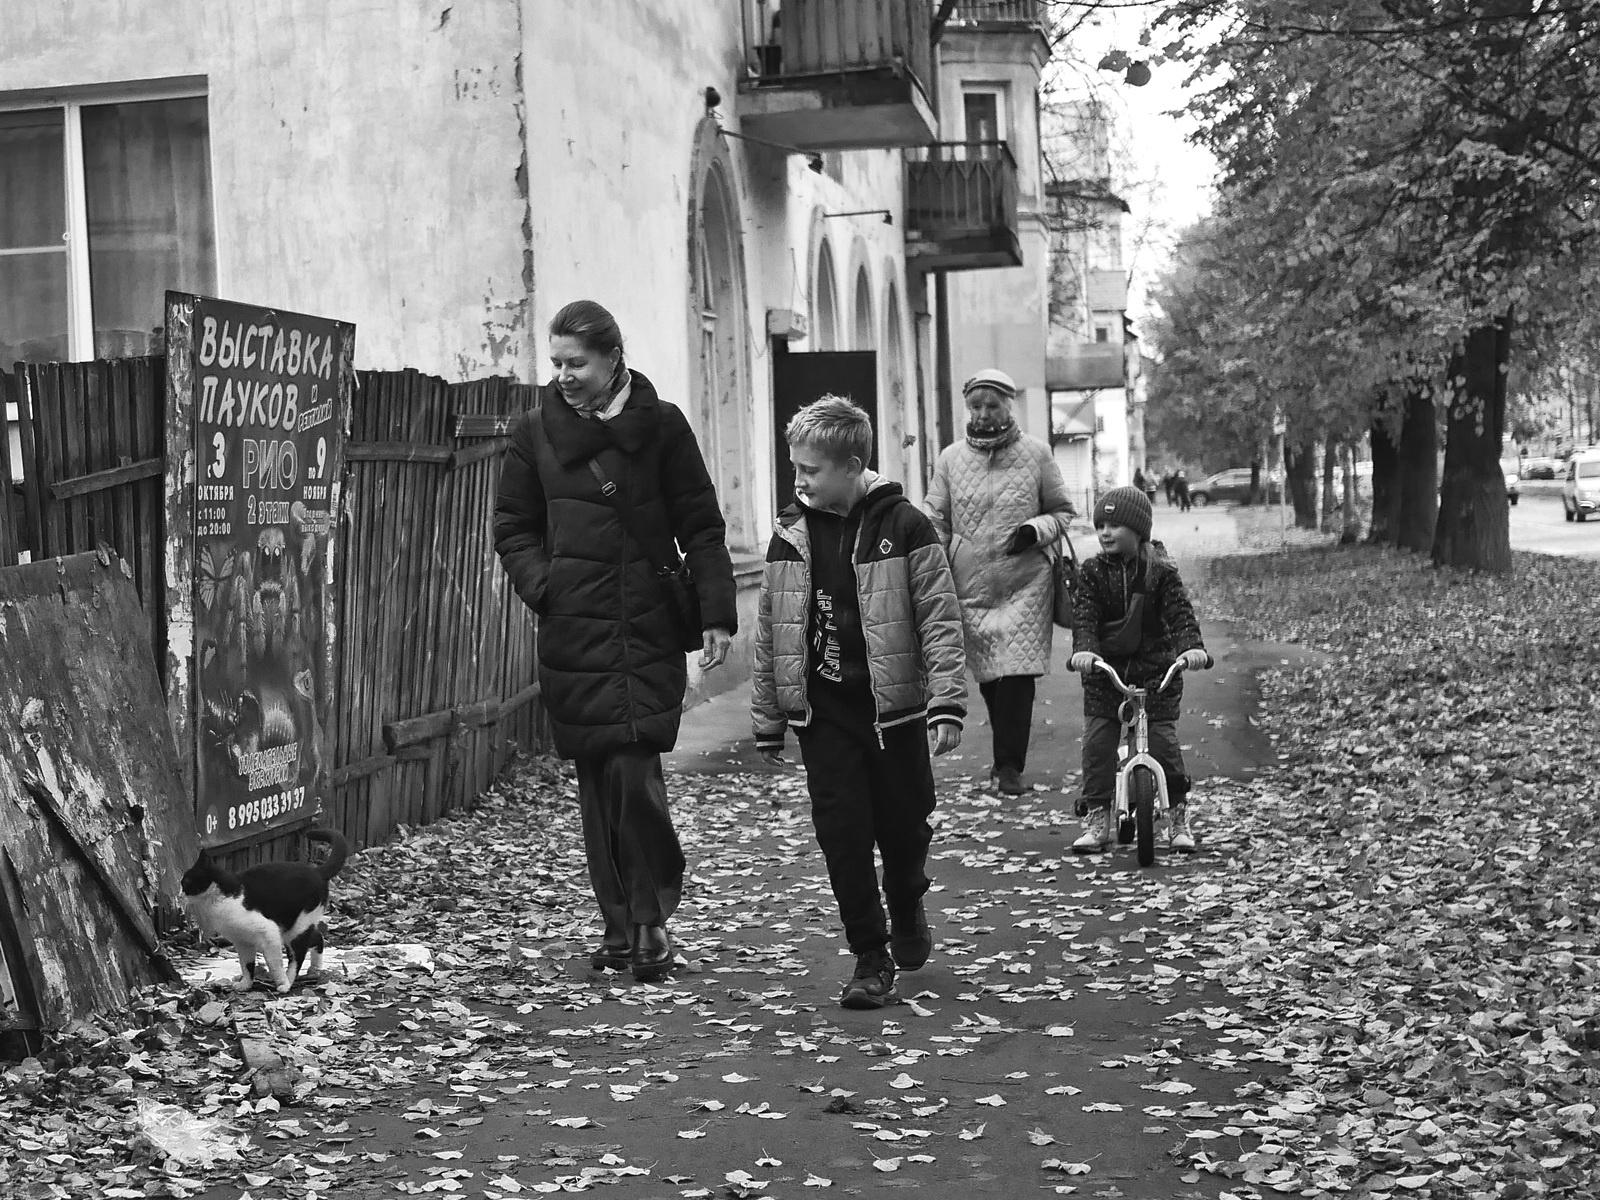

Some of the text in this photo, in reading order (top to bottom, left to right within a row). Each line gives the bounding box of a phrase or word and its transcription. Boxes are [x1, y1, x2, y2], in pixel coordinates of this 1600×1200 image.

[199, 315, 333, 380] ВЫСТАВКА
[199, 375, 299, 431] ПАУКОВ
[212, 431, 226, 479] 3
[242, 438, 298, 491] РИО
[308, 436, 327, 479] по 9
[197, 485, 234, 501] ОКТЯБРЯ
[247, 494, 290, 525] 2 этаж
[303, 485, 327, 500] НОЯБРЯ
[197, 507, 226, 520] с 11:00
[197, 522, 231, 537] до 20:00
[206, 813, 218, 834] 0+
[228, 785, 305, 830] 8 995 033 31 37
